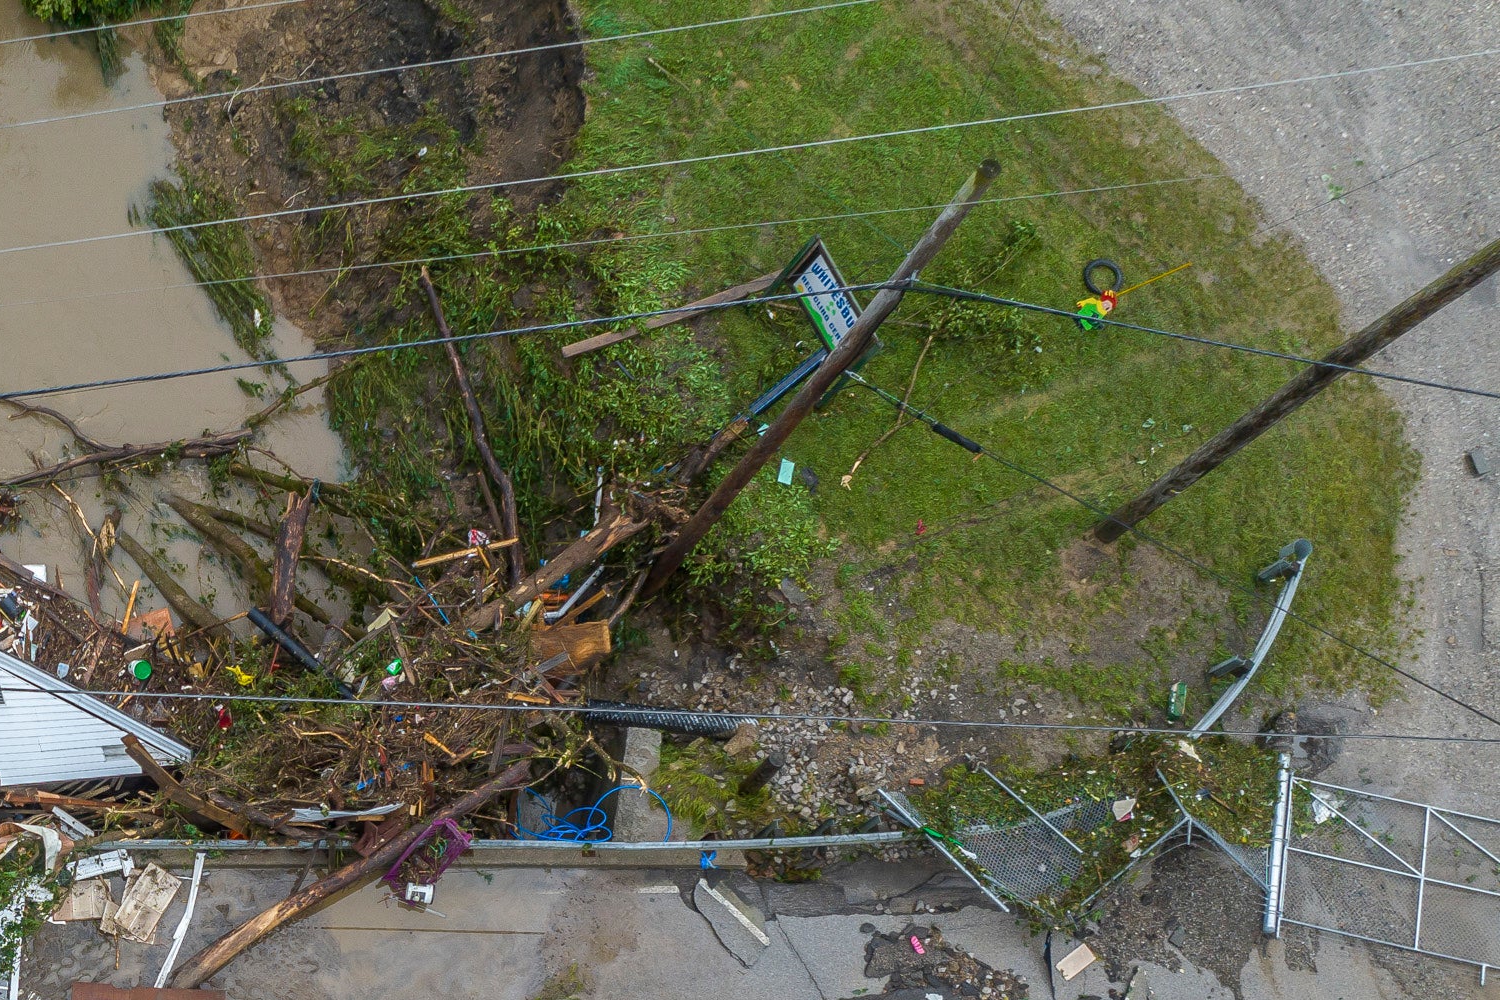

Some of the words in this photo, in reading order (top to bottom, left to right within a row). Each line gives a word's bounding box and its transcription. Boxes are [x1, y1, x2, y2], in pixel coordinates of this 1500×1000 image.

[801, 275, 830, 322] RECCLING
[828, 322, 843, 341] CEN
[811, 262, 855, 328] WHITESBU
